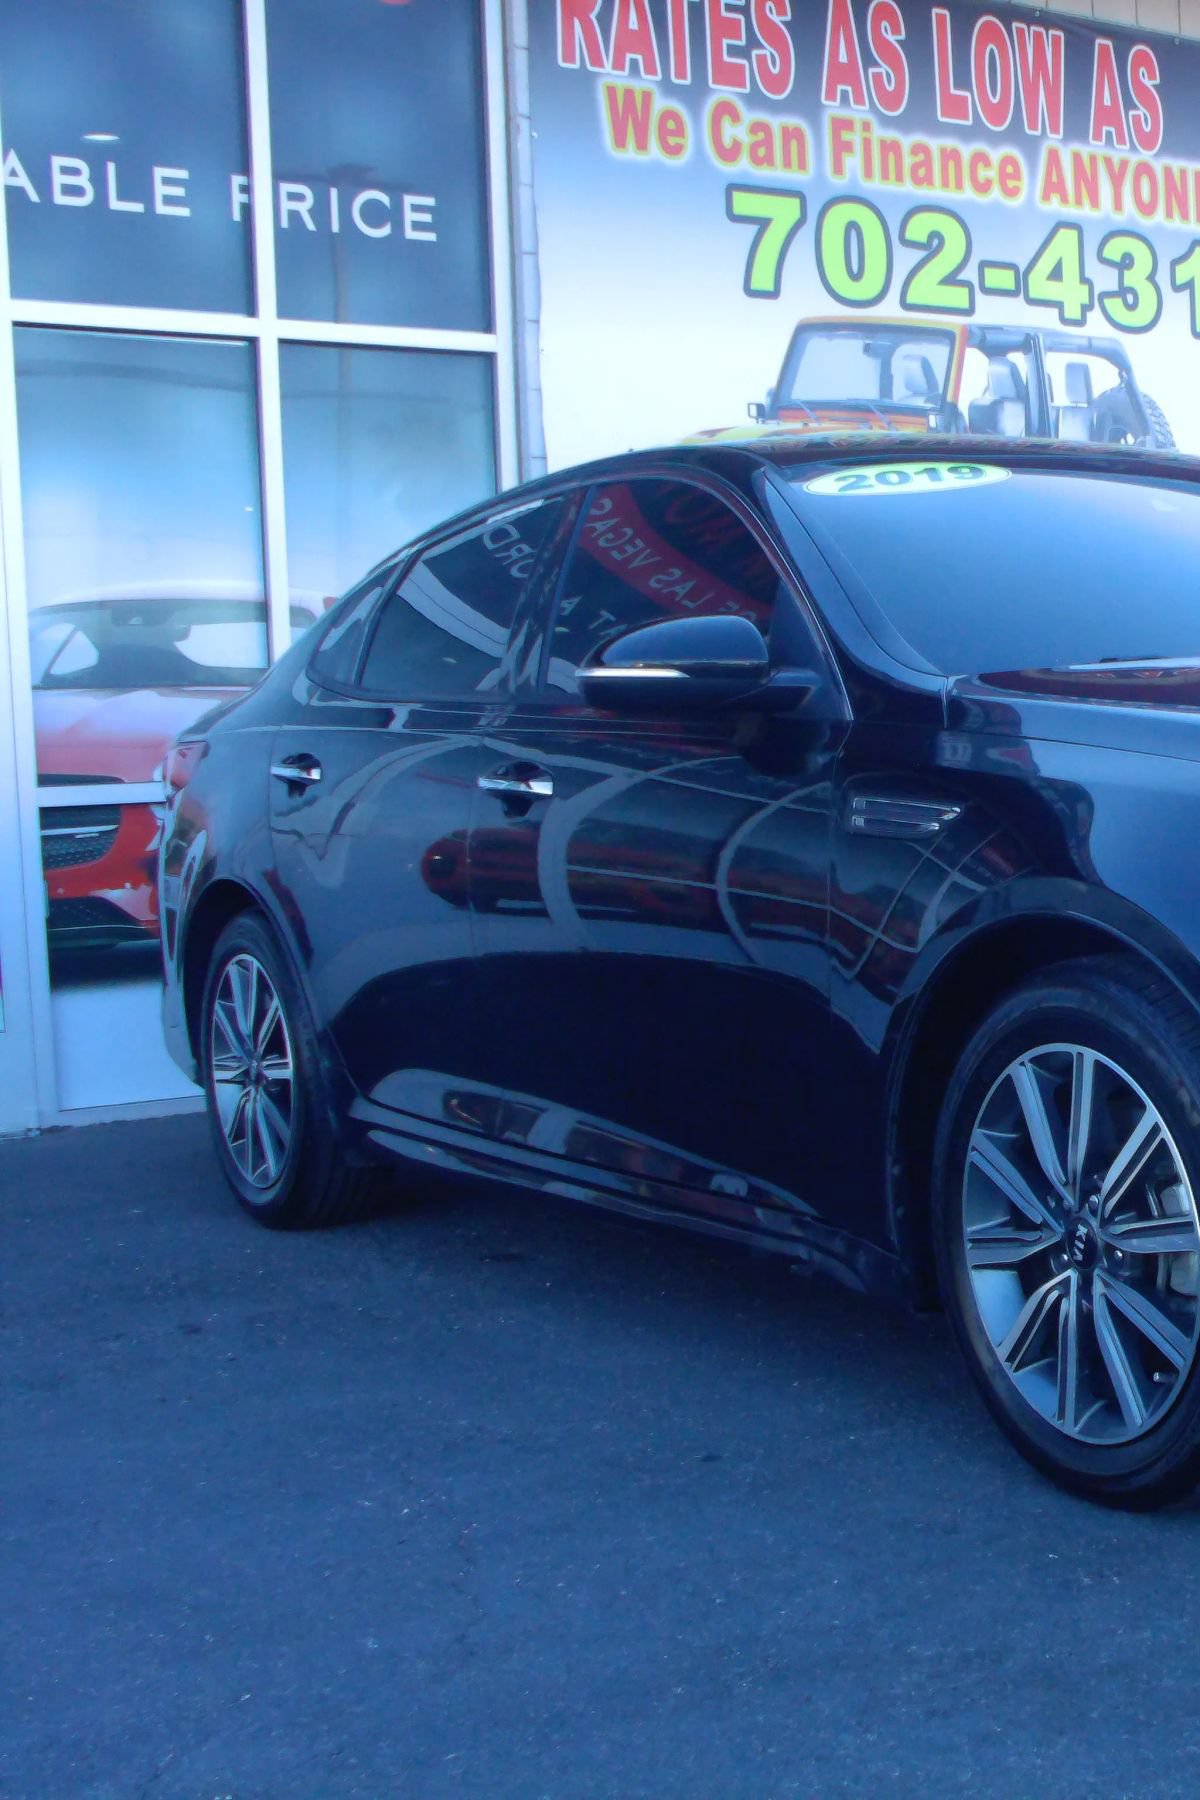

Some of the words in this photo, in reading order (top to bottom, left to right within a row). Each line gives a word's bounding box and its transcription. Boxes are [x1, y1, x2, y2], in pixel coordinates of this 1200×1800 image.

[557, 0, 795, 99] RATES
[821, 0, 910, 117] AS
[931, 6, 1065, 139] LOW
[1089, 38, 1164, 155] AS
[602, 81, 687, 158] We
[709, 95, 812, 174] Can
[828, 113, 1025, 201] Finance
[2, 148, 191, 217] ABLE
[833, 465, 987, 492] 2019
[1073, 1223, 1088, 1261] KIA
